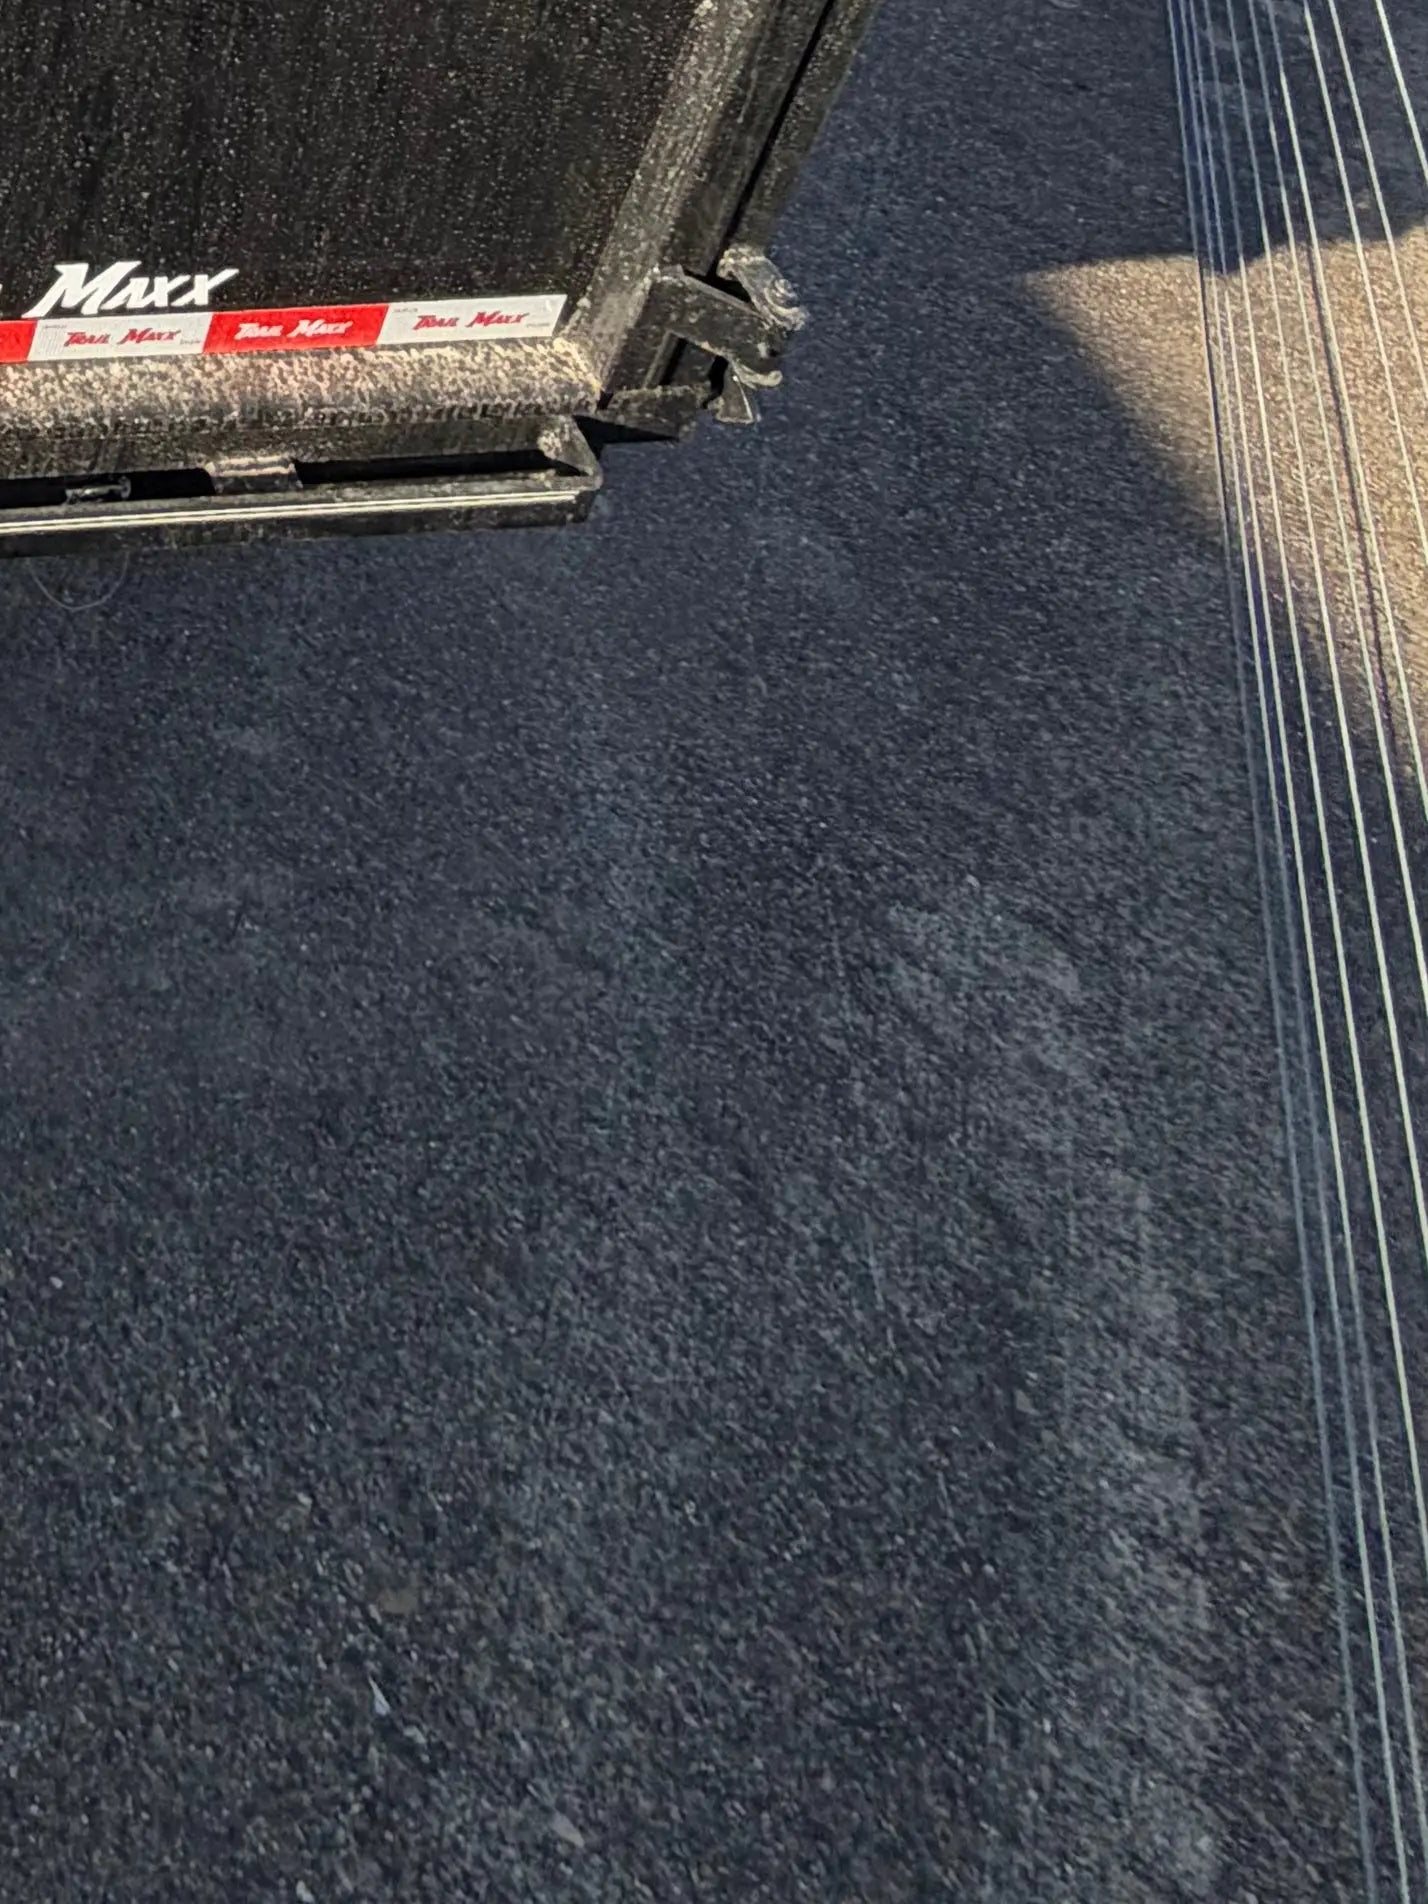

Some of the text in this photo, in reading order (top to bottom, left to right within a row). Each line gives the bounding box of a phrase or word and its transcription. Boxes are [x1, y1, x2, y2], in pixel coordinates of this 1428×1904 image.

[234, 322, 283, 340] TRAIL
[412, 314, 460, 331] TRAIL
[63, 330, 112, 347] TRAIL
